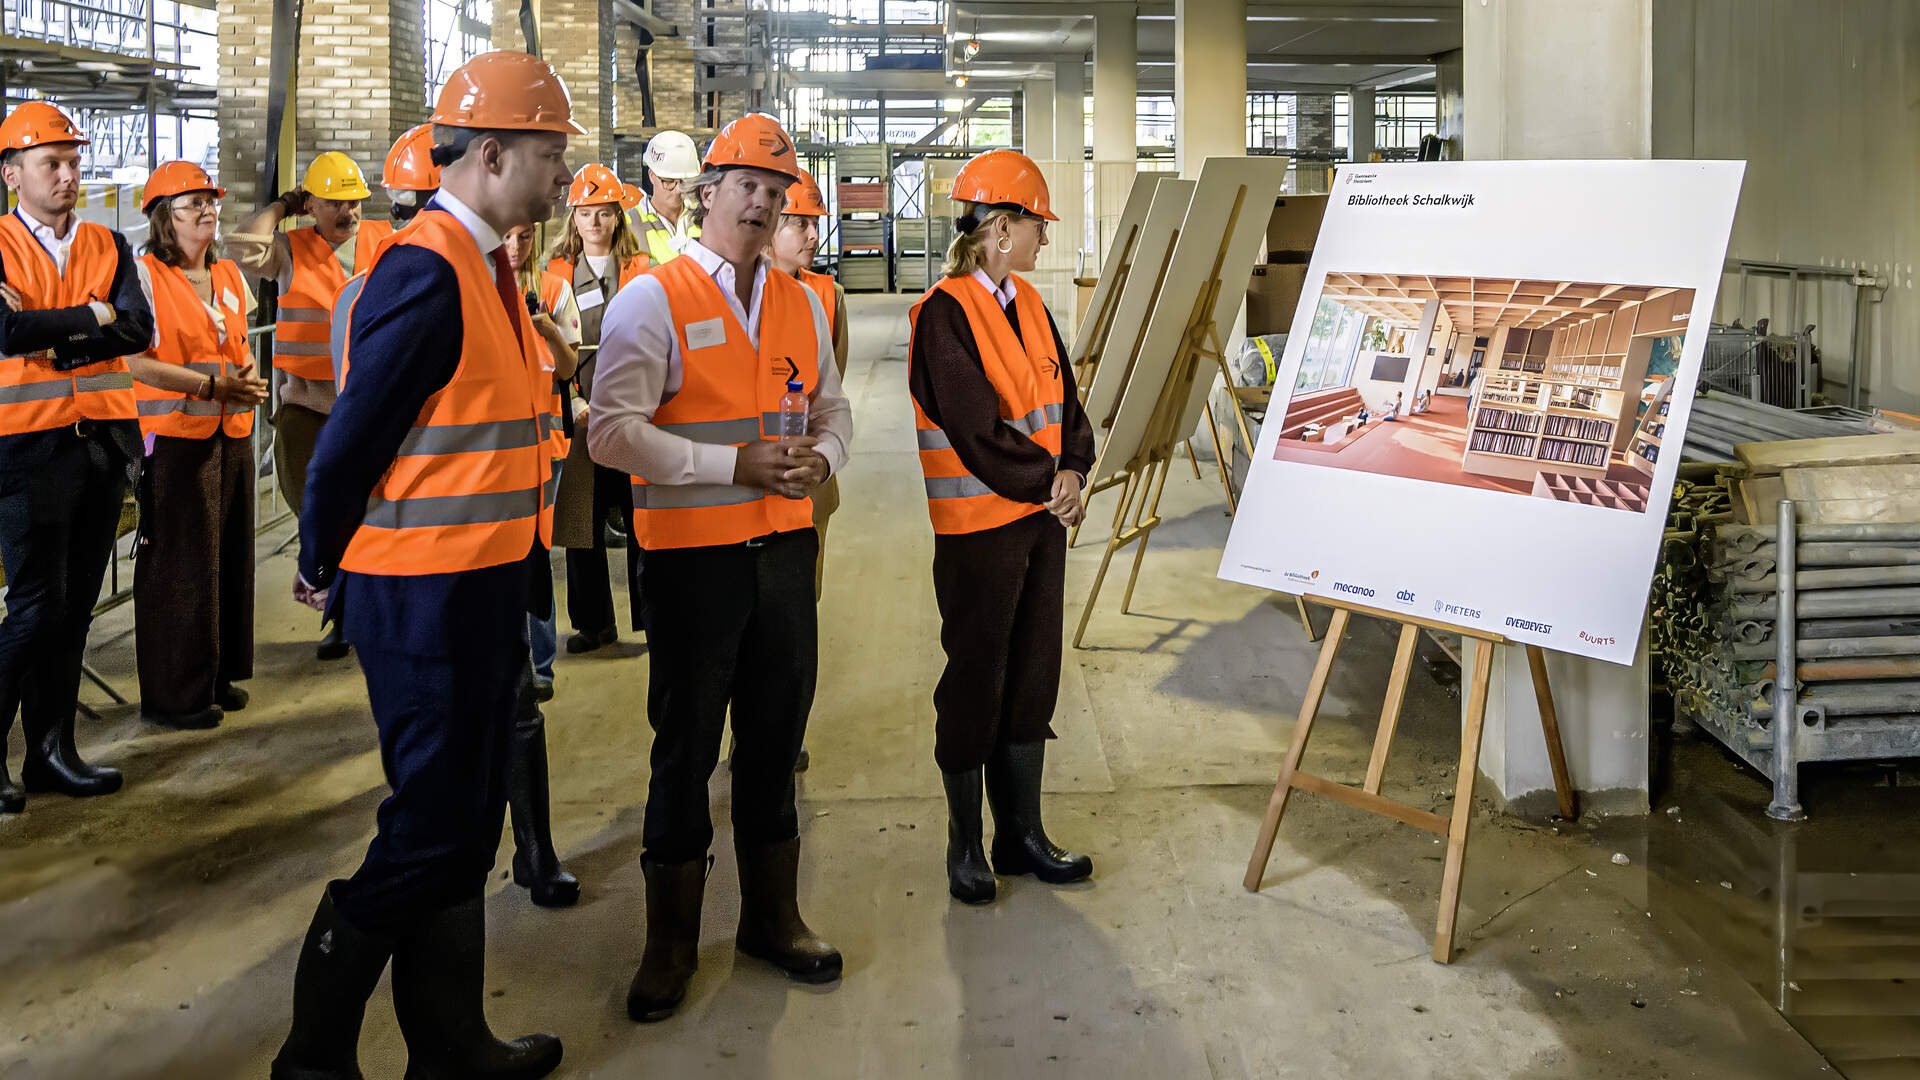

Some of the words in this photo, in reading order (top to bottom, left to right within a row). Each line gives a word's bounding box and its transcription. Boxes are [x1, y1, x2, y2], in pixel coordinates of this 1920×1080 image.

[1347, 194, 1410, 206] Bibliotheek
[1412, 194, 1476, 209] Schalkwijk
[1333, 581, 1375, 598] mecanoo
[1396, 589, 1416, 602] abt
[1444, 603, 1481, 619] PIETERS
[1579, 630, 1615, 646] BUURTS
